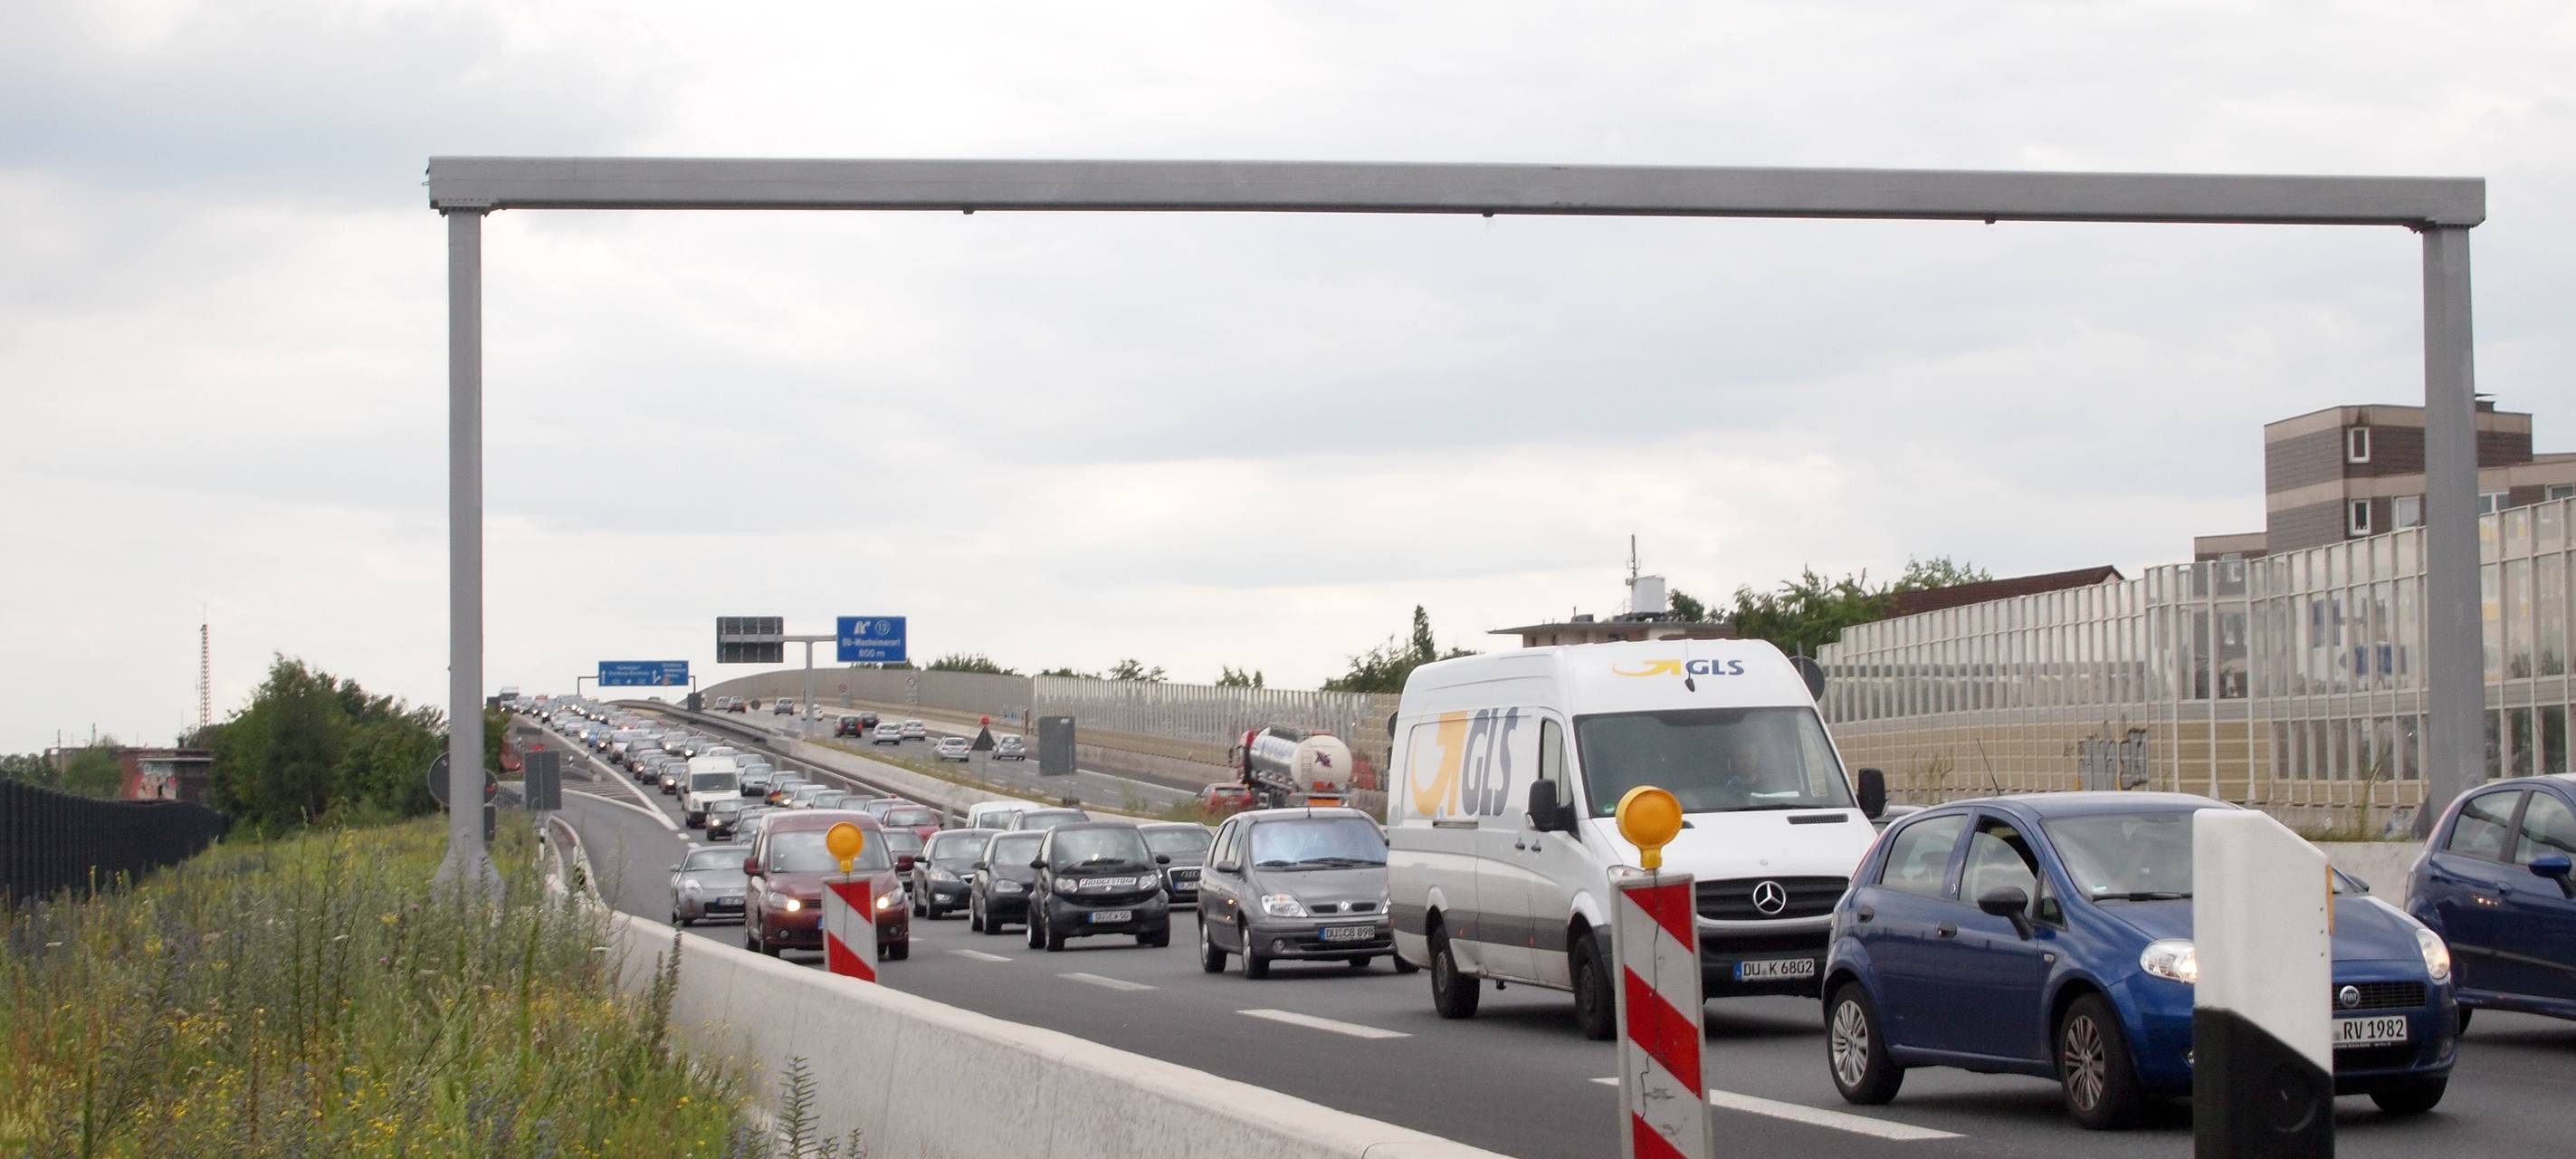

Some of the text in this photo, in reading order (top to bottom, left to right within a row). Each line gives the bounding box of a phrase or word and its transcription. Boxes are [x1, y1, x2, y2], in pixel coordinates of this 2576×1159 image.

[1685, 659, 1745, 675] GLS
[1462, 706, 1519, 817] GLS
[1326, 927, 1338, 937] DU
[1743, 961, 1813, 976] DU K 6802
[2343, 992, 2357, 1001] FIAT
[2343, 1020, 2404, 1039] RV 1982
